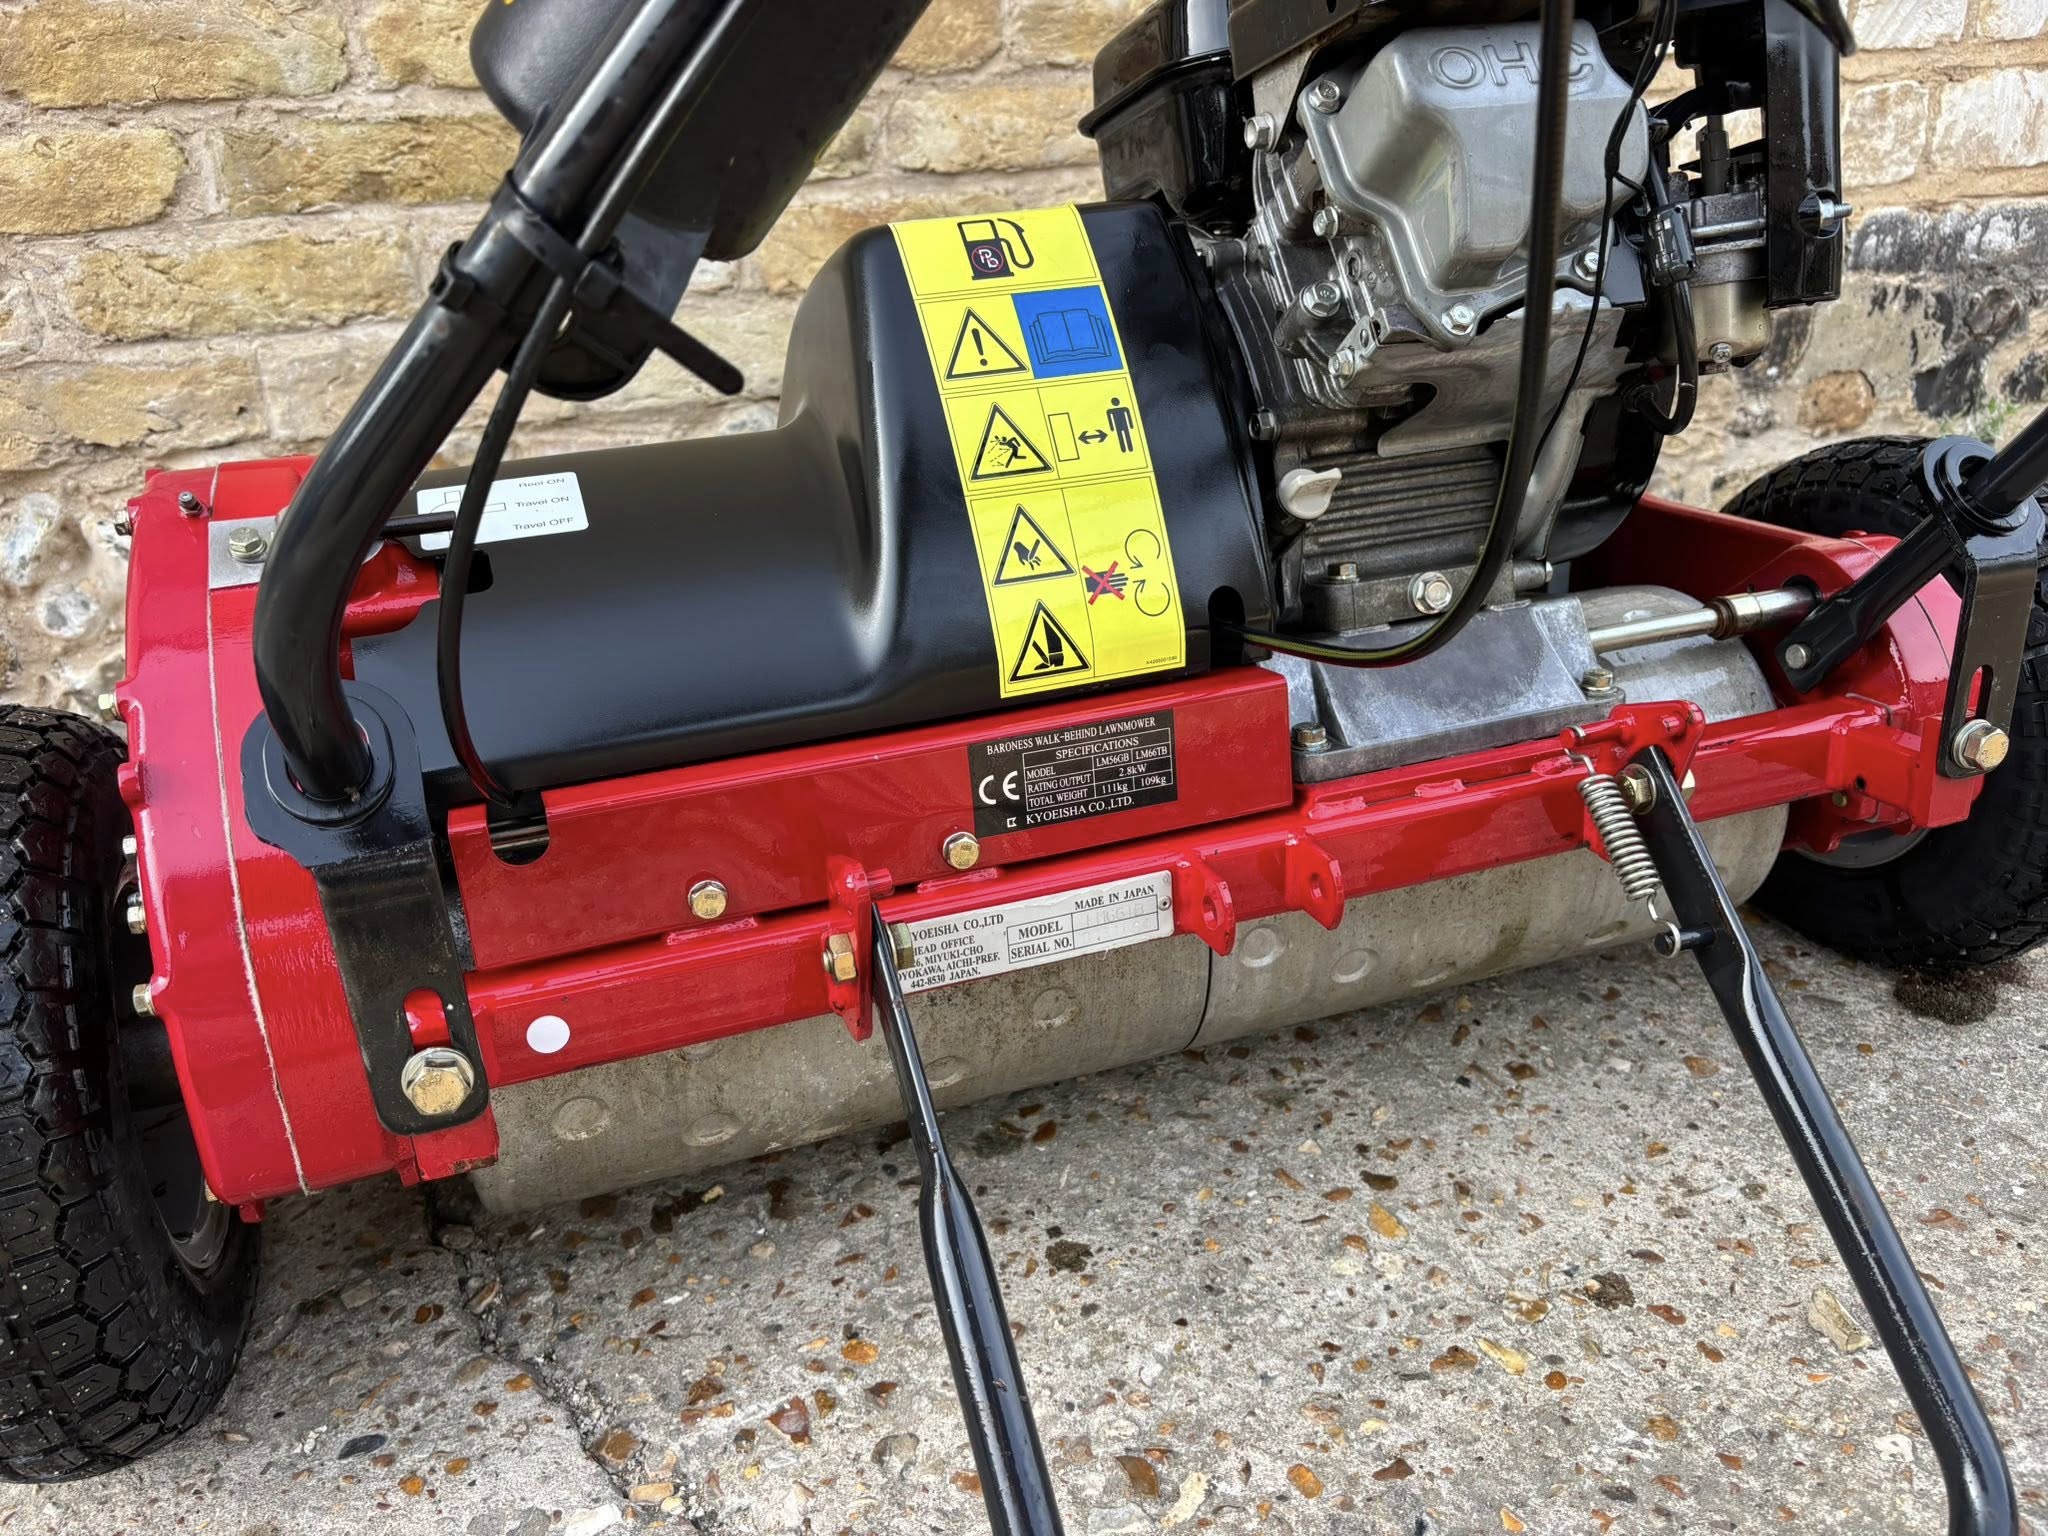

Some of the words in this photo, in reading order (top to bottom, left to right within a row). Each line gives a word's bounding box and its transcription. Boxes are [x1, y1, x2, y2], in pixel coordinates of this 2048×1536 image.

[518, 480, 544, 488] Reel
[546, 477, 565, 485] ON
[514, 498, 548, 508] Travel
[551, 496, 570, 504] ON
[512, 521, 546, 530] Travel
[549, 516, 574, 526] OFF
[986, 738, 1034, 756] BARONESS
[1034, 727, 1097, 746] WALK-BEHIND
[1099, 716, 1156, 736] LAWNMOWER
[1055, 736, 1140, 760] SPECIFICATIONS
[1026, 766, 1056, 780] MODEL
[1096, 752, 1130, 767] LM56GB
[1135, 745, 1168, 760] LM66TB
[1027, 780, 1058, 794] RATING
[1059, 773, 1092, 788] OUTPUT
[1118, 763, 1147, 777] 2.8kW
[1029, 794, 1055, 808] TOTAL
[1055, 788, 1089, 802] WEIGHT
[1102, 782, 1129, 794] 111kg
[1140, 775, 1167, 787] 109kg
[1026, 804, 1087, 825] KYOEISHA
[1088, 795, 1135, 813] CO.,LTD.
[1075, 895, 1105, 911] MADE
[1109, 892, 1120, 904] IN
[1123, 884, 1156, 900] JAPAN
[911, 922, 960, 942] YOEISHA
[963, 913, 1004, 931] CO.,LTD
[1018, 921, 1064, 940] MODEL
[925, 945, 984, 965] MIYUKI-CHO
[941, 935, 976, 951] OFFICE
[1010, 943, 1051, 960] SERIAL
[1053, 936, 1073, 950] NO.
[898, 965, 945, 981] YOKAWA,
[946, 951, 1001, 971] AICHI-PREF.
[910, 973, 946, 989] 442-8530
[949, 966, 981, 982] JAPAN.
